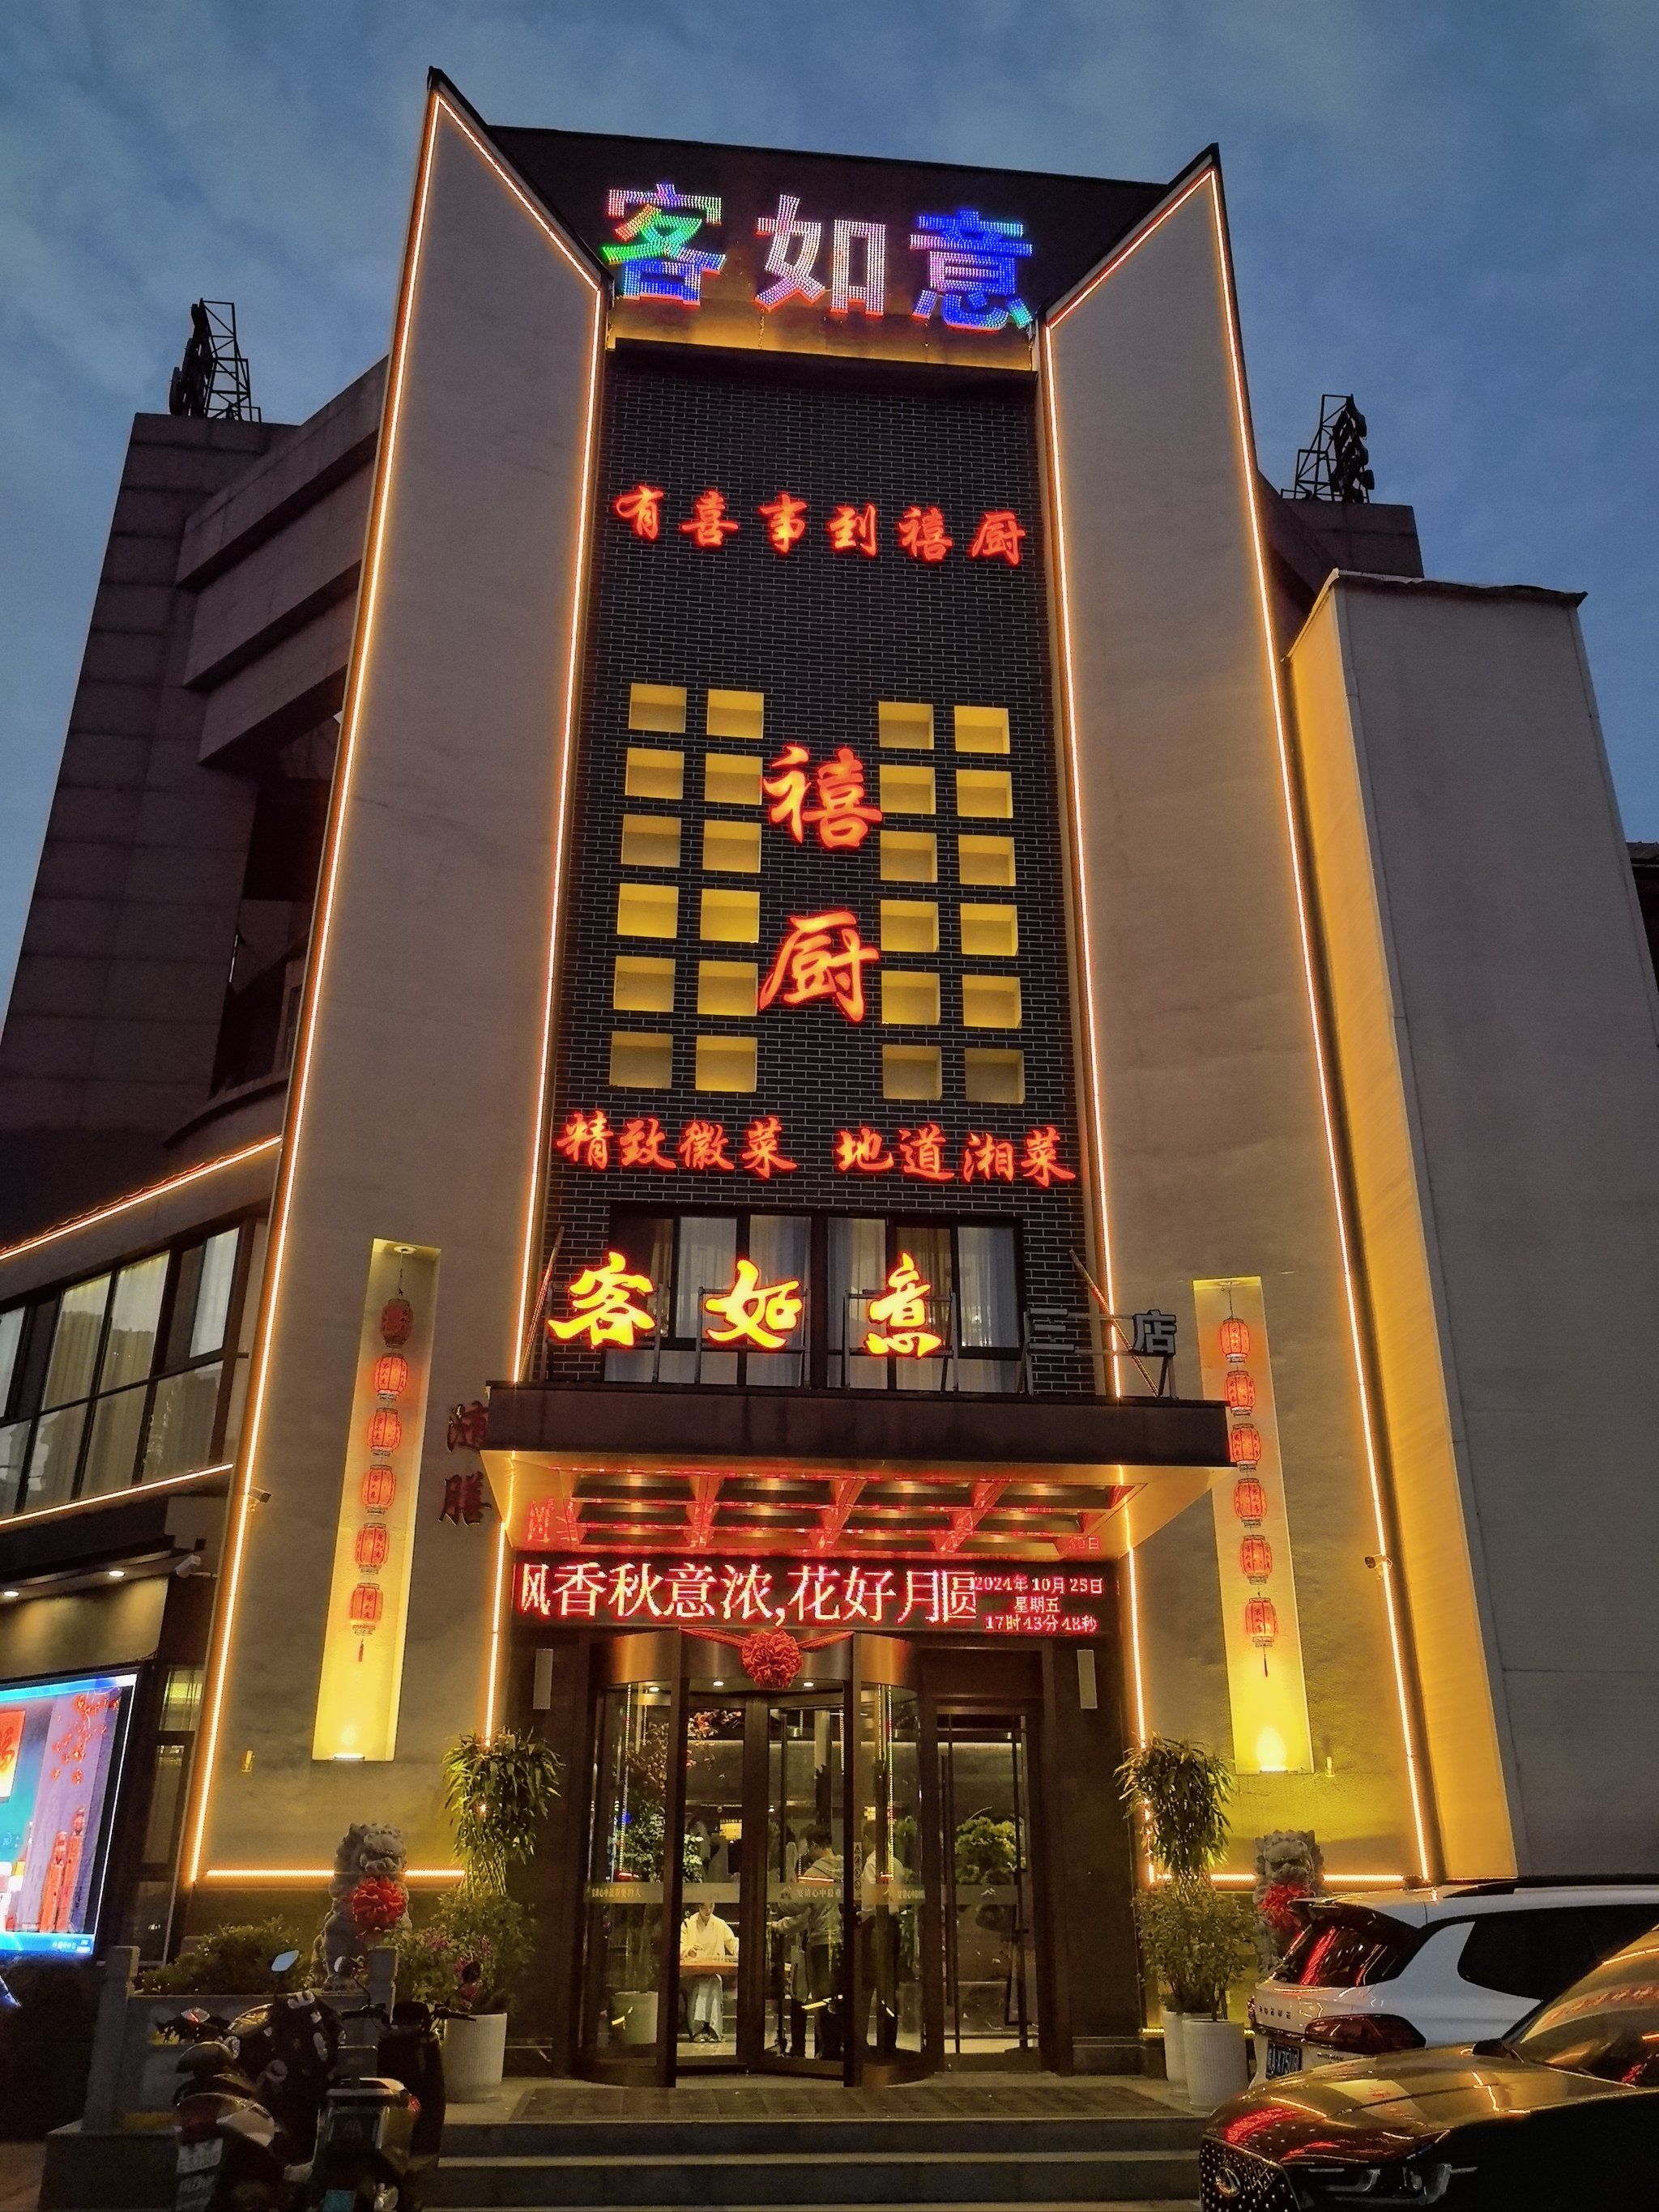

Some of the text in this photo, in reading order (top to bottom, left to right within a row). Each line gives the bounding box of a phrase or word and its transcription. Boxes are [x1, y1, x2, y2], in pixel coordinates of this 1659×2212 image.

[602, 182, 1034, 330] 客如意
[615, 485, 1027, 565] 有喜事到禧厨
[758, 745, 883, 1022] 禧厨
[557, 1110, 1077, 1187] 精致徽菜 地道湘菜
[547, 1251, 943, 1359] 客如意
[1014, 1596, 1060, 1613] 星期五
